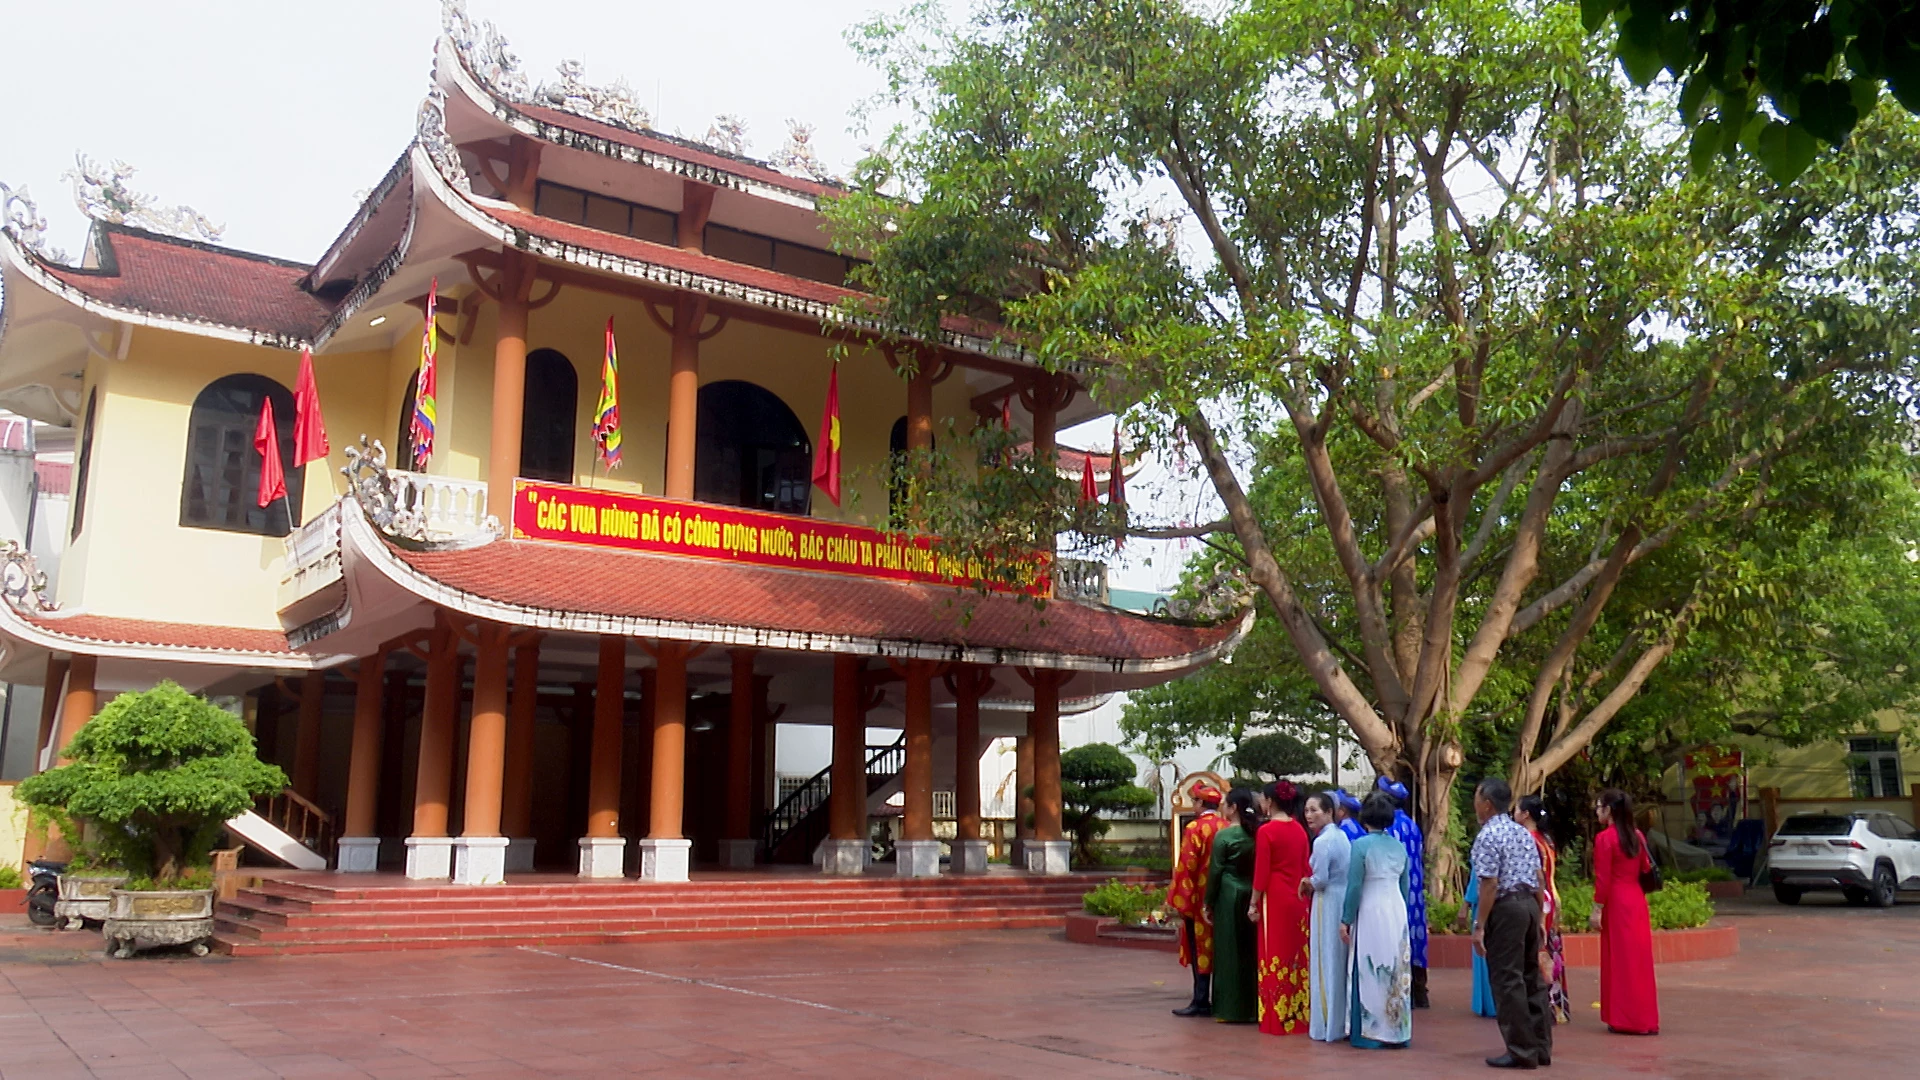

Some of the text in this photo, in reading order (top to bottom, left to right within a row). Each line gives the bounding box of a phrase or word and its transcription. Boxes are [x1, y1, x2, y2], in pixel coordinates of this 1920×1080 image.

[570, 504, 597, 534] VUA
[600, 504, 639, 540] HÙNG
[641, 509, 660, 542] ĐÃ
[663, 511, 682, 544] CÓ
[684, 513, 720, 548] CÔNG
[723, 522, 757, 556] DỰNG
[760, 525, 797, 561] NƯỚC,
[799, 529, 824, 561] BÁC
[827, 533, 857, 564] CHÁU
[860, 541, 873, 566] TA
[875, 538, 902, 570] PHẢI
[904, 543, 934, 573] CÙNG
